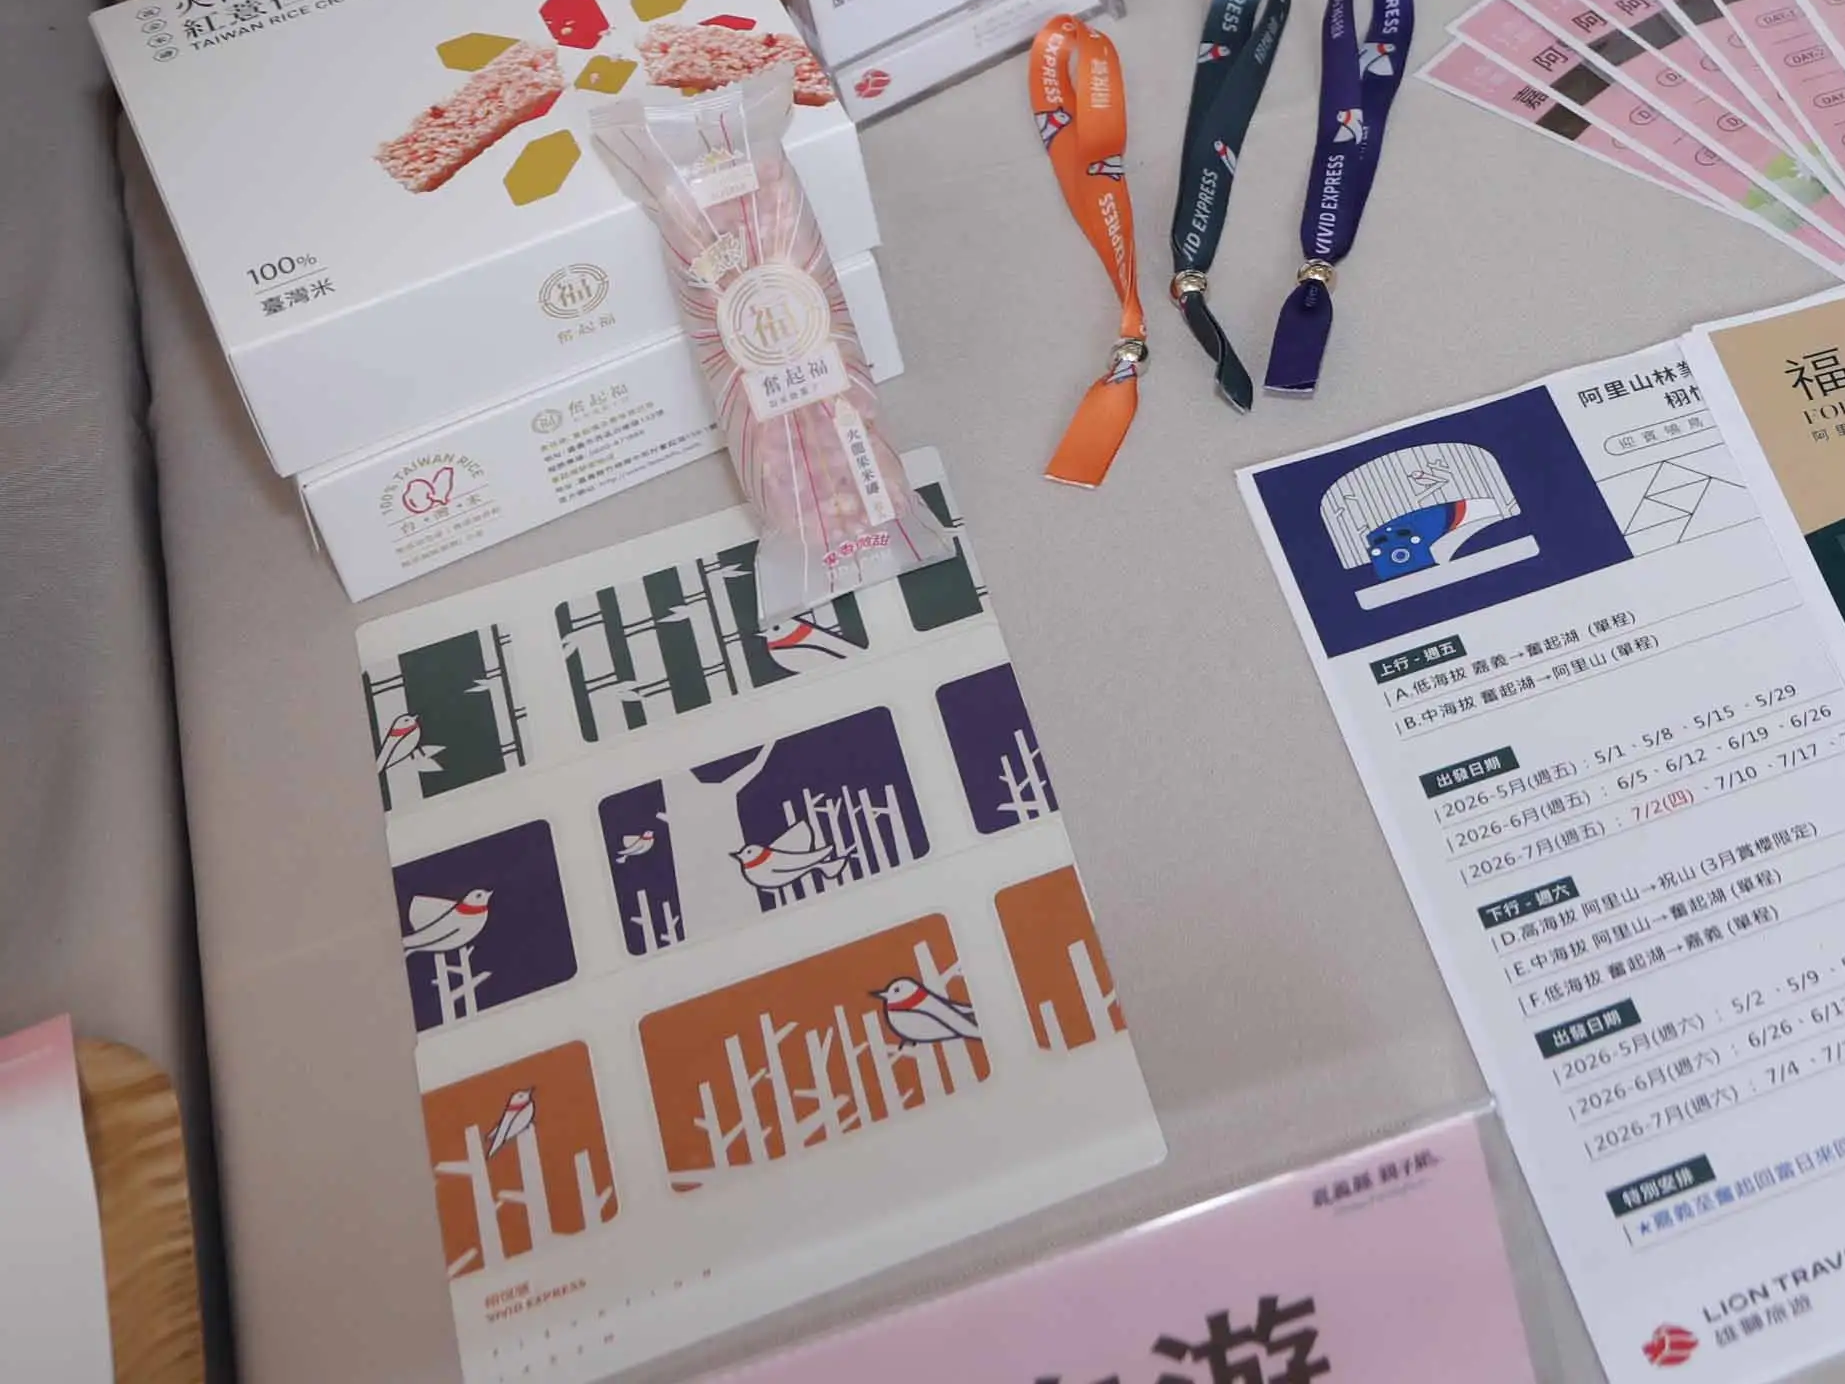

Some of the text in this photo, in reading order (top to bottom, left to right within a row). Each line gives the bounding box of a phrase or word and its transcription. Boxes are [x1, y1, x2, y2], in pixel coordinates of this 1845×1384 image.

[191, 21, 266, 52] TAIWAN
[267, 6, 311, 28] RICE
[1193, 168, 1218, 232] EXPRESS
[1315, 153, 1345, 257] VIVID EXPRESS
[246, 250, 319, 286] 100%
[259, 276, 338, 318] 臺灣米
[393, 453, 455, 482] TAIWAN
[1434, 755, 1503, 789] 出發日期
[1701, 1282, 1771, 1323] LION
